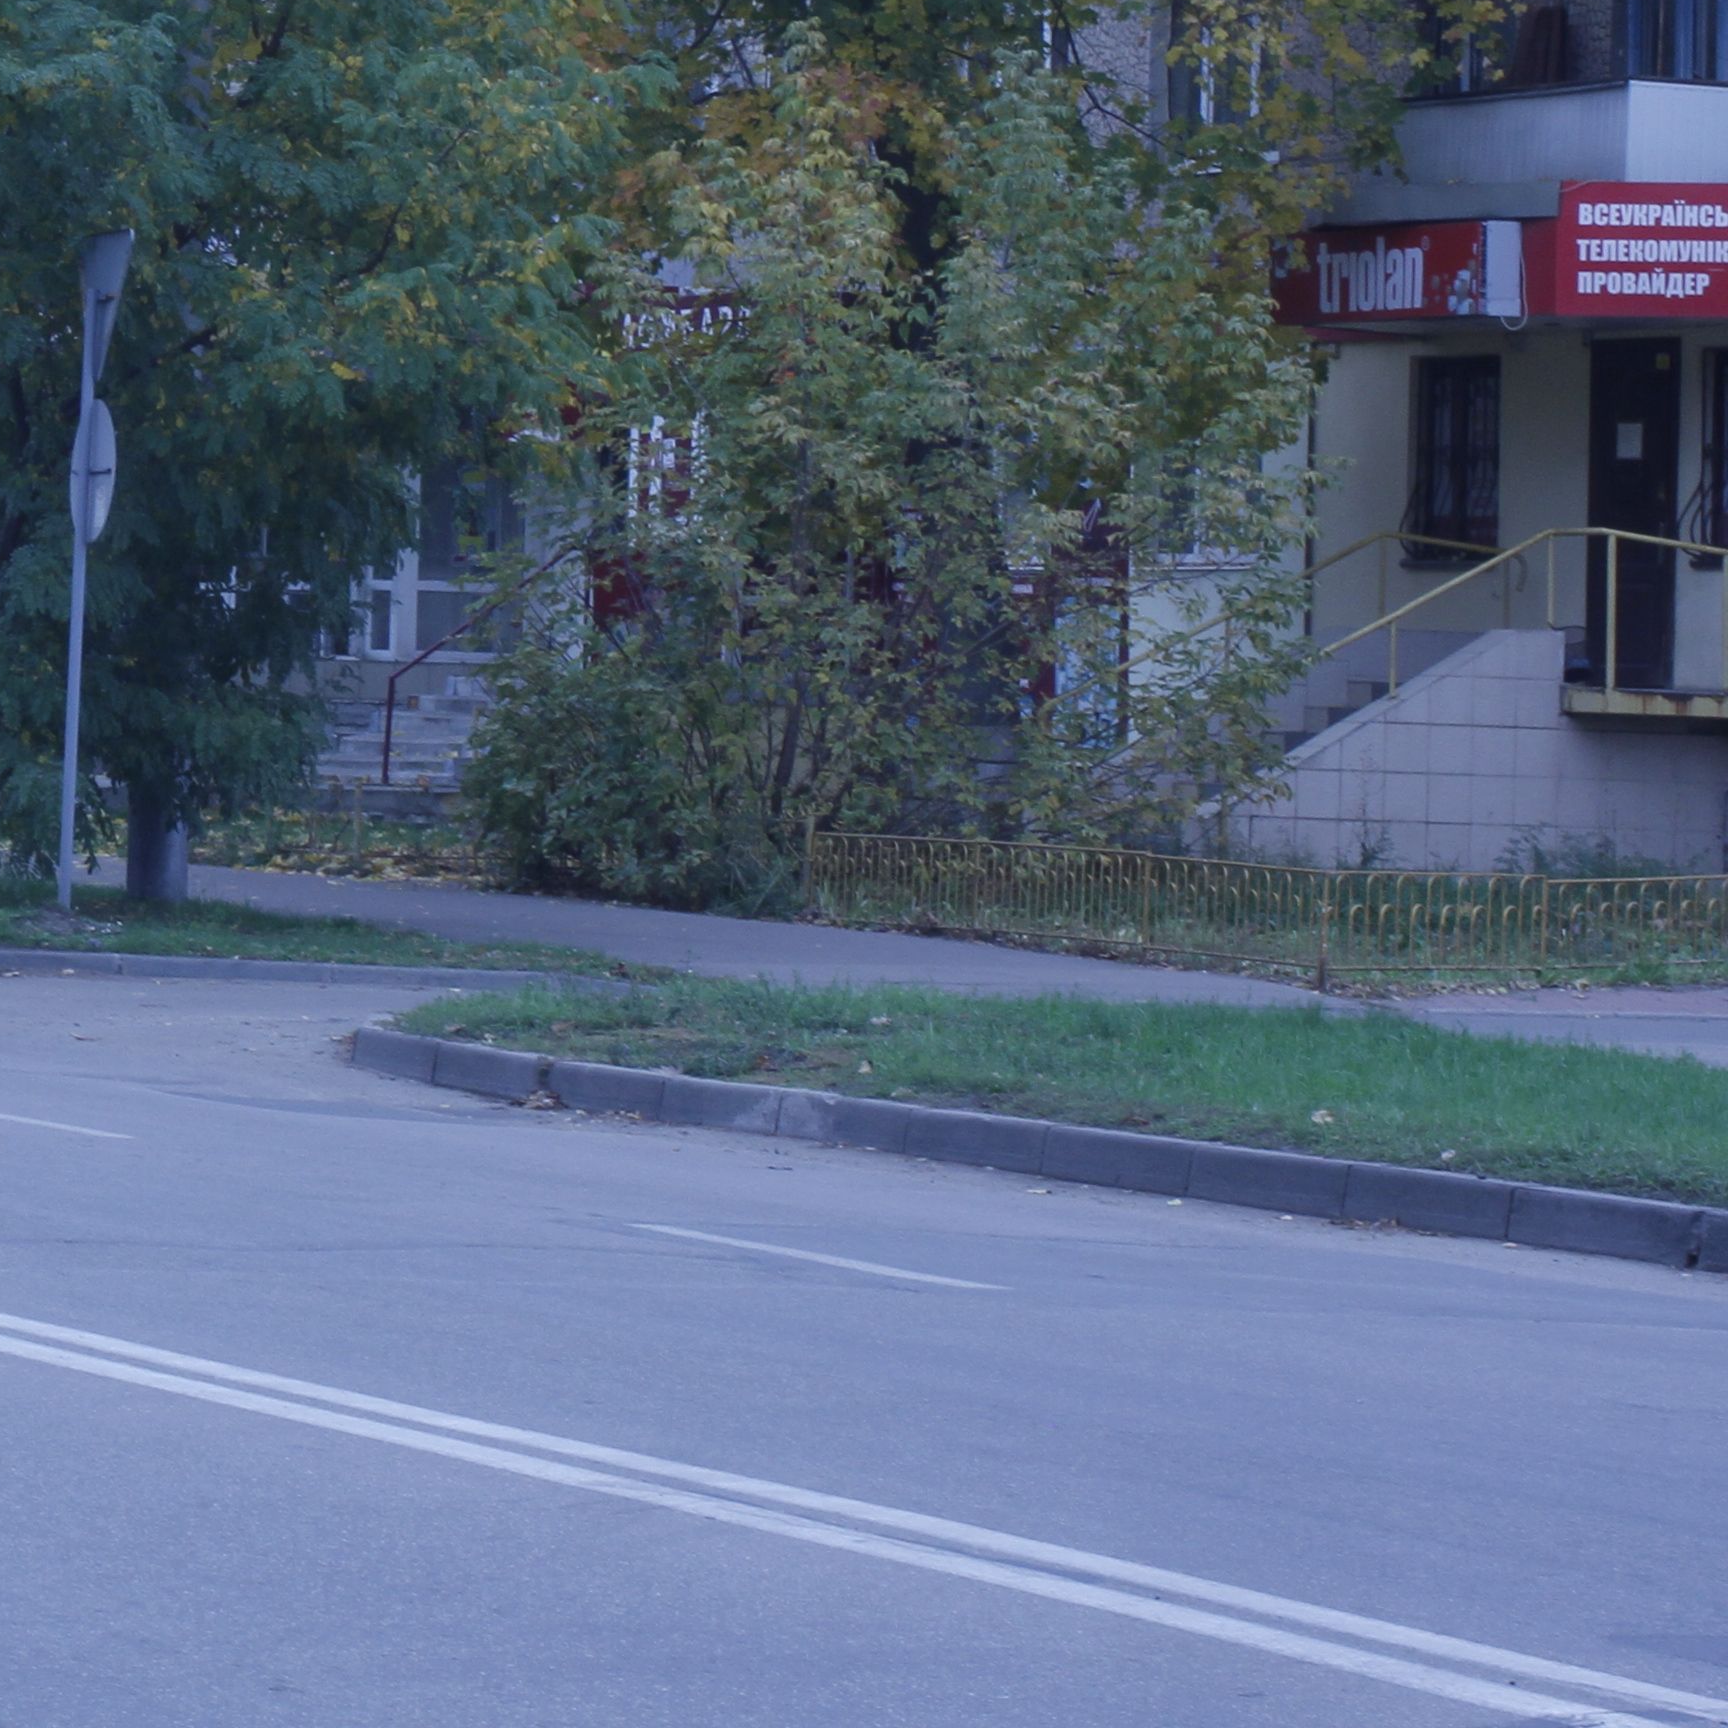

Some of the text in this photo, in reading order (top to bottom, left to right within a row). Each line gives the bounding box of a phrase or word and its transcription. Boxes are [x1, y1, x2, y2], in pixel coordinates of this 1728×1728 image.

[1578, 199, 1728, 227] ВСЕУКРАЇНСЬ
[1576, 238, 1728, 263] ТЕЛЕКОМУНІК
[1317, 236, 1423, 313] triolan
[1577, 267, 1710, 298] ПРОВАЙДЕР
